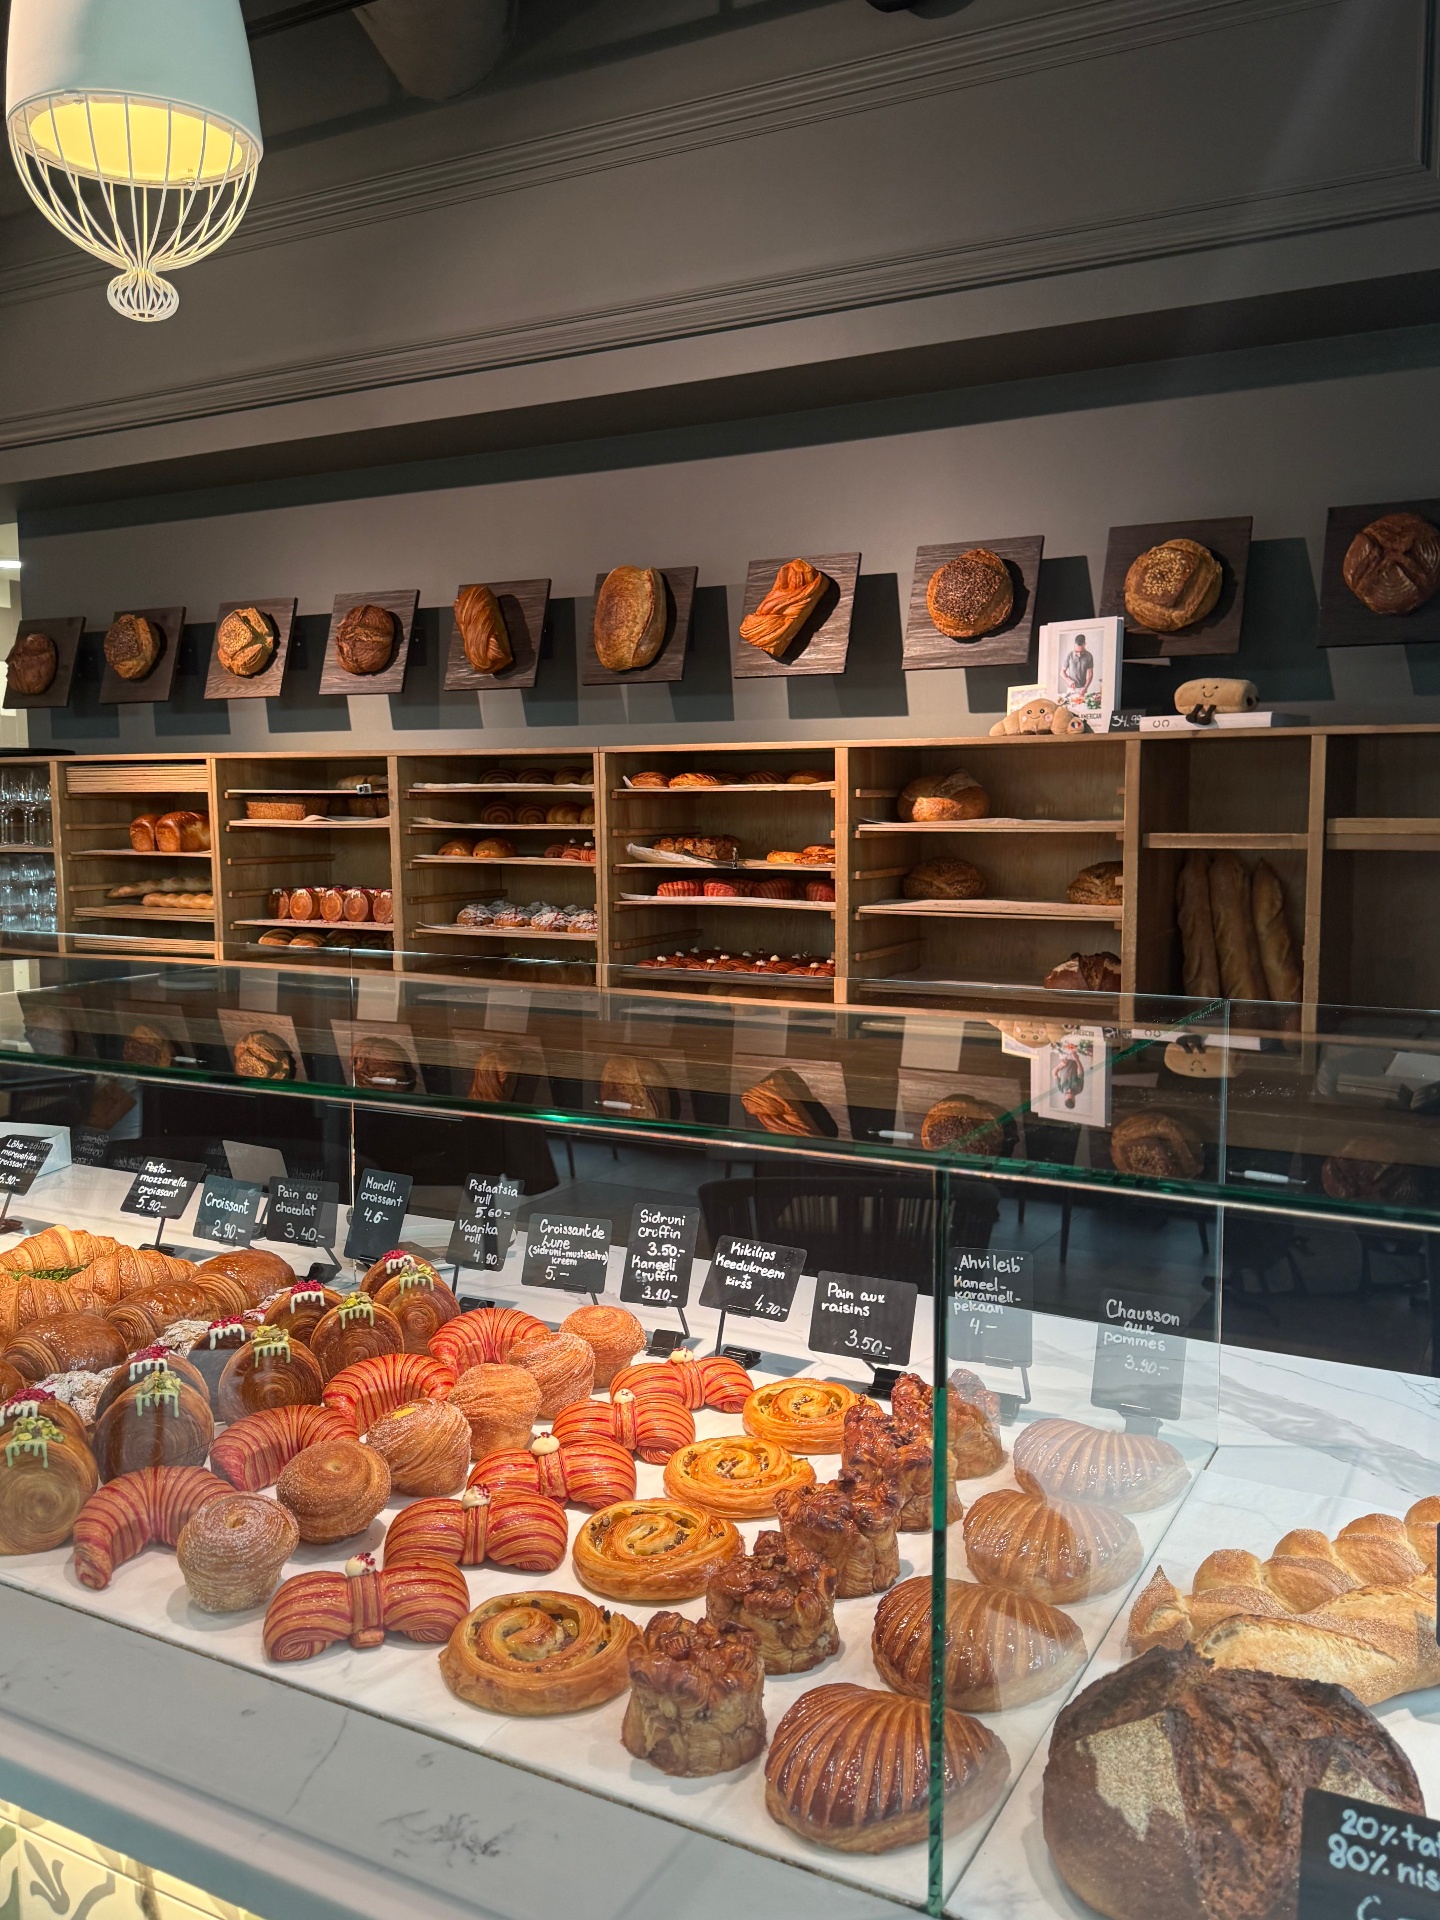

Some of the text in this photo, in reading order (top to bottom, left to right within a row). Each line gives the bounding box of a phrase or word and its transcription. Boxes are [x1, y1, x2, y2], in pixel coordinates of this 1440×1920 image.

[145, 1161, 172, 1174] Pesto-
[139, 1174, 188, 1188] mozzarella
[365, 1175, 397, 1194] Mandli
[469, 1179, 518, 1198] Pistaatsia
[138, 1185, 179, 1198] croissant
[277, 1184, 300, 1200] Pain
[305, 1192, 319, 1201] au
[360, 1192, 404, 1207] croissant
[473, 1194, 492, 1205] rull
[204, 1191, 250, 1215] Croissant
[275, 1202, 317, 1217] chocolat
[640, 1208, 686, 1226] Sidruni
[459, 1219, 498, 1235] Vaarika
[539, 1218, 606, 1240] Croissant de
[637, 1224, 681, 1239] cruffin
[464, 1234, 482, 1245] rull
[730, 1241, 777, 1262] Kikilips
[631, 1254, 677, 1272] Kaneeli
[715, 1252, 786, 1280] Keedukreem
[635, 1269, 678, 1283] cruffin
[725, 1275, 753, 1290] kirss
[953, 1274, 1007, 1292] Kaneel-
[827, 1281, 854, 1300] Pain
[954, 1290, 1022, 1304] karamell-
[821, 1302, 870, 1317] raisins
[953, 1300, 1004, 1315] pekaan
[1105, 1298, 1180, 1327] Chausson
[1103, 1331, 1166, 1352] pommes
[1328, 1832, 1390, 1876] 80%
